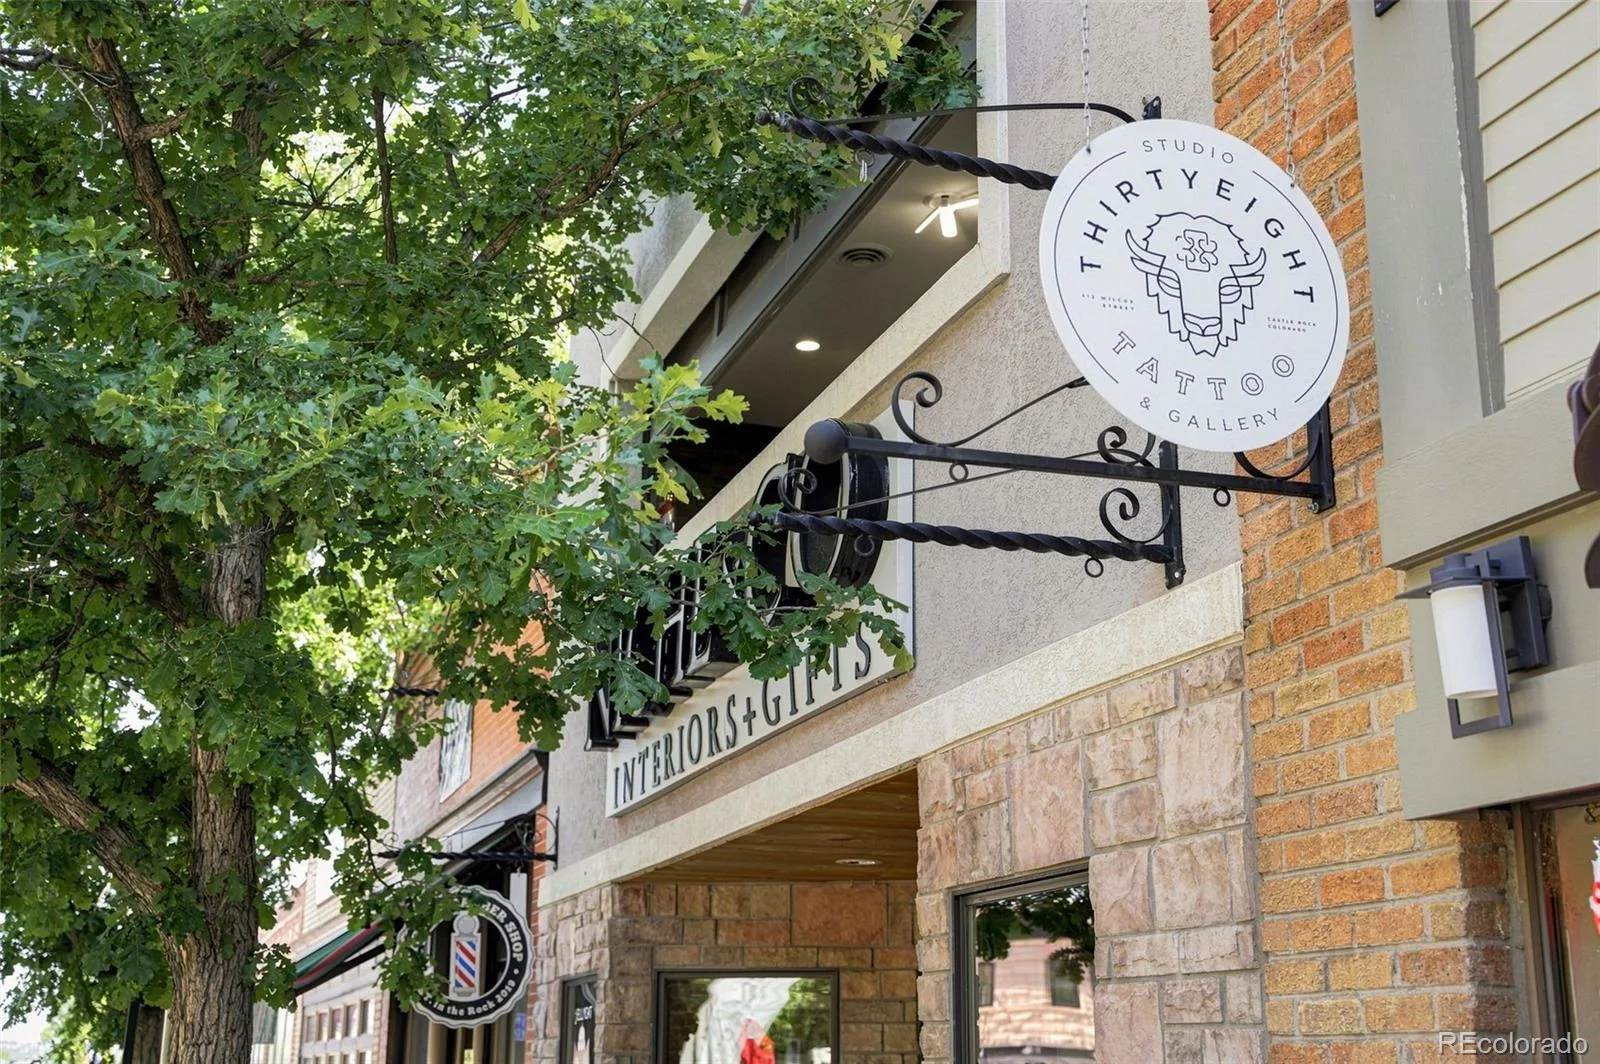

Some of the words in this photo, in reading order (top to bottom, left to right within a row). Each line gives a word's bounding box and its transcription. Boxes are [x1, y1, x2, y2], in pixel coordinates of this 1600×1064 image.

[1142, 138, 1235, 165] STUDIO
[1080, 168, 1314, 303] THIRTYEIGHT
[1267, 316, 1294, 324] CASTLE
[1297, 320, 1317, 328] ROCK
[1267, 324, 1307, 333] COLORADO
[1112, 331, 1295, 400] TATTOO
[1139, 396, 1151, 410] &
[1168, 407, 1280, 432] GALLERY
[504, 921, 524, 962] SHOP
[446, 1005, 465, 1016] the
[467, 1000, 495, 1016] Rock
[495, 979, 516, 1004] 2019
